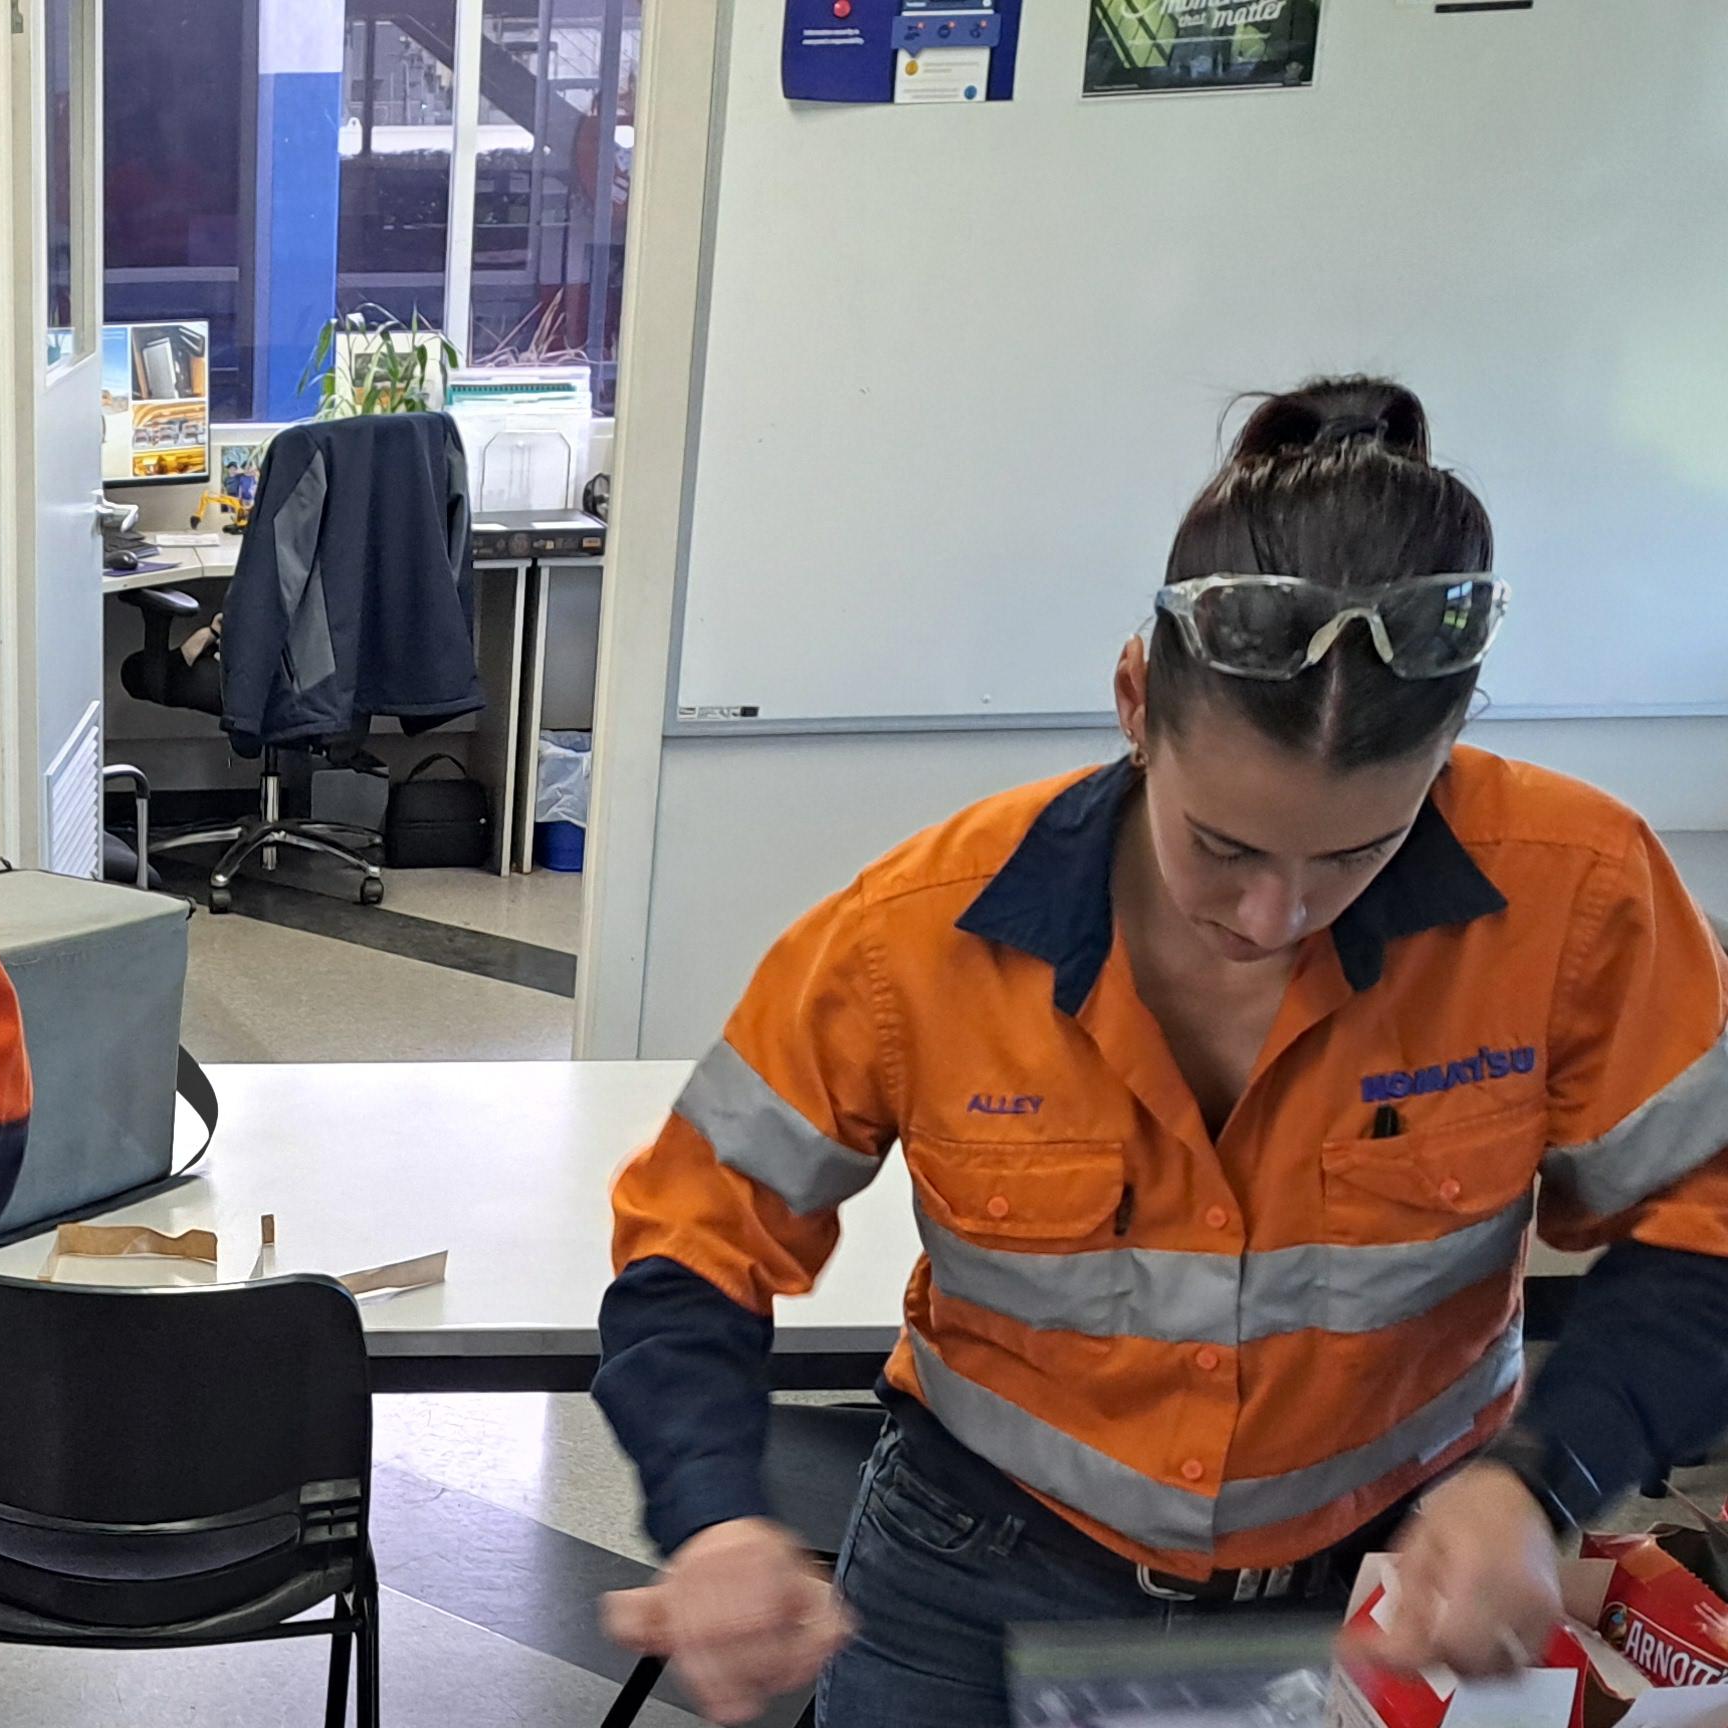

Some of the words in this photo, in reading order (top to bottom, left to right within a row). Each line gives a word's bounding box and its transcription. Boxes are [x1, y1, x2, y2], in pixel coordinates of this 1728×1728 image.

[1179, 10, 1205, 27] that
[1361, 1046, 1535, 1103] KOMATSU
[967, 1093, 1045, 1114] ALLEY
